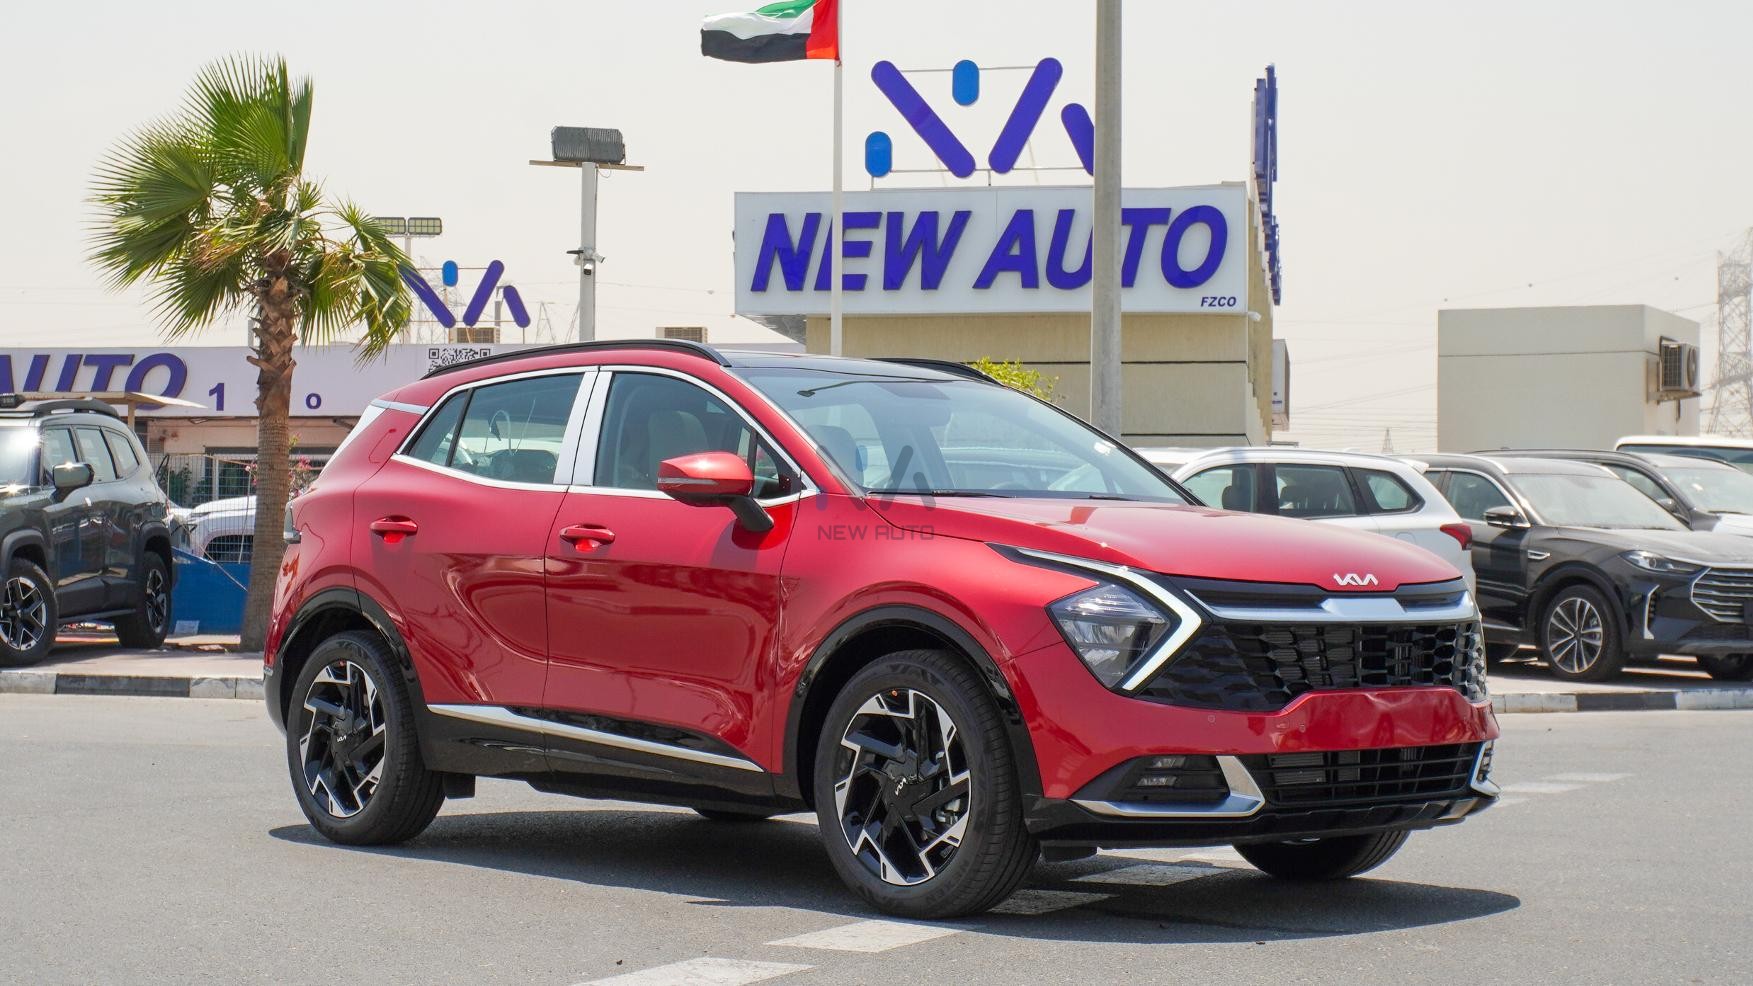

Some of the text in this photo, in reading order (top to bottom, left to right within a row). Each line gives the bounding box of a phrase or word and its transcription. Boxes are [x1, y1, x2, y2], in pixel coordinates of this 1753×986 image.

[751, 205, 1229, 292] NEW AUTO
[1201, 296, 1237, 307] FZCO
[0, 353, 187, 410] UTO
[208, 382, 225, 411] 1
[1333, 573, 1379, 586] KIA
